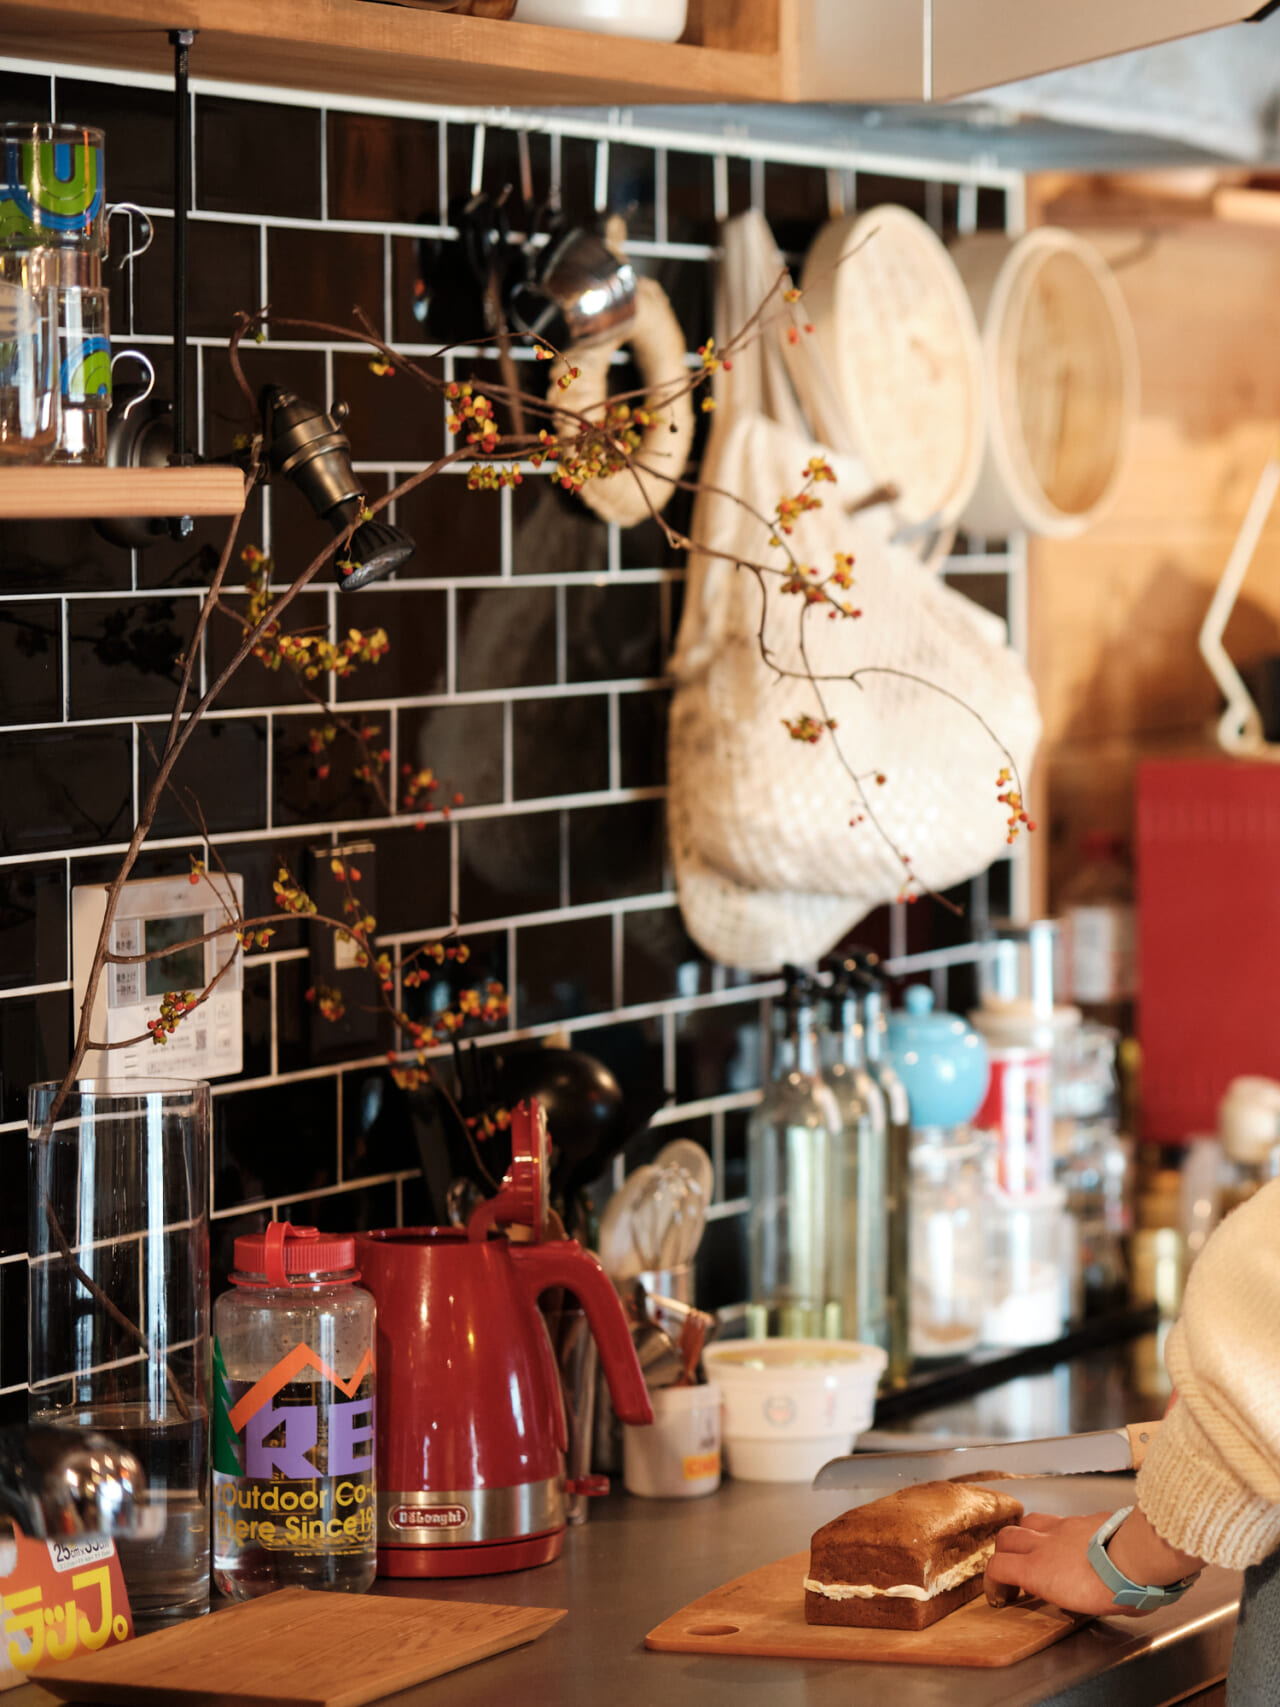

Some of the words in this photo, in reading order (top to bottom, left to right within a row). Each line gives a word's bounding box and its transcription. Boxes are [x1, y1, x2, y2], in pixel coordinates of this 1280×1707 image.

[246, 1398, 376, 1479] RE
[218, 1511, 276, 1540] There
[285, 1516, 357, 1540] Since
[359, 1506, 376, 1533] 19
[222, 1482, 328, 1511] Outdoor
[336, 1481, 376, 1506] Co-
[0, 1565, 129, 1672] ラップ
